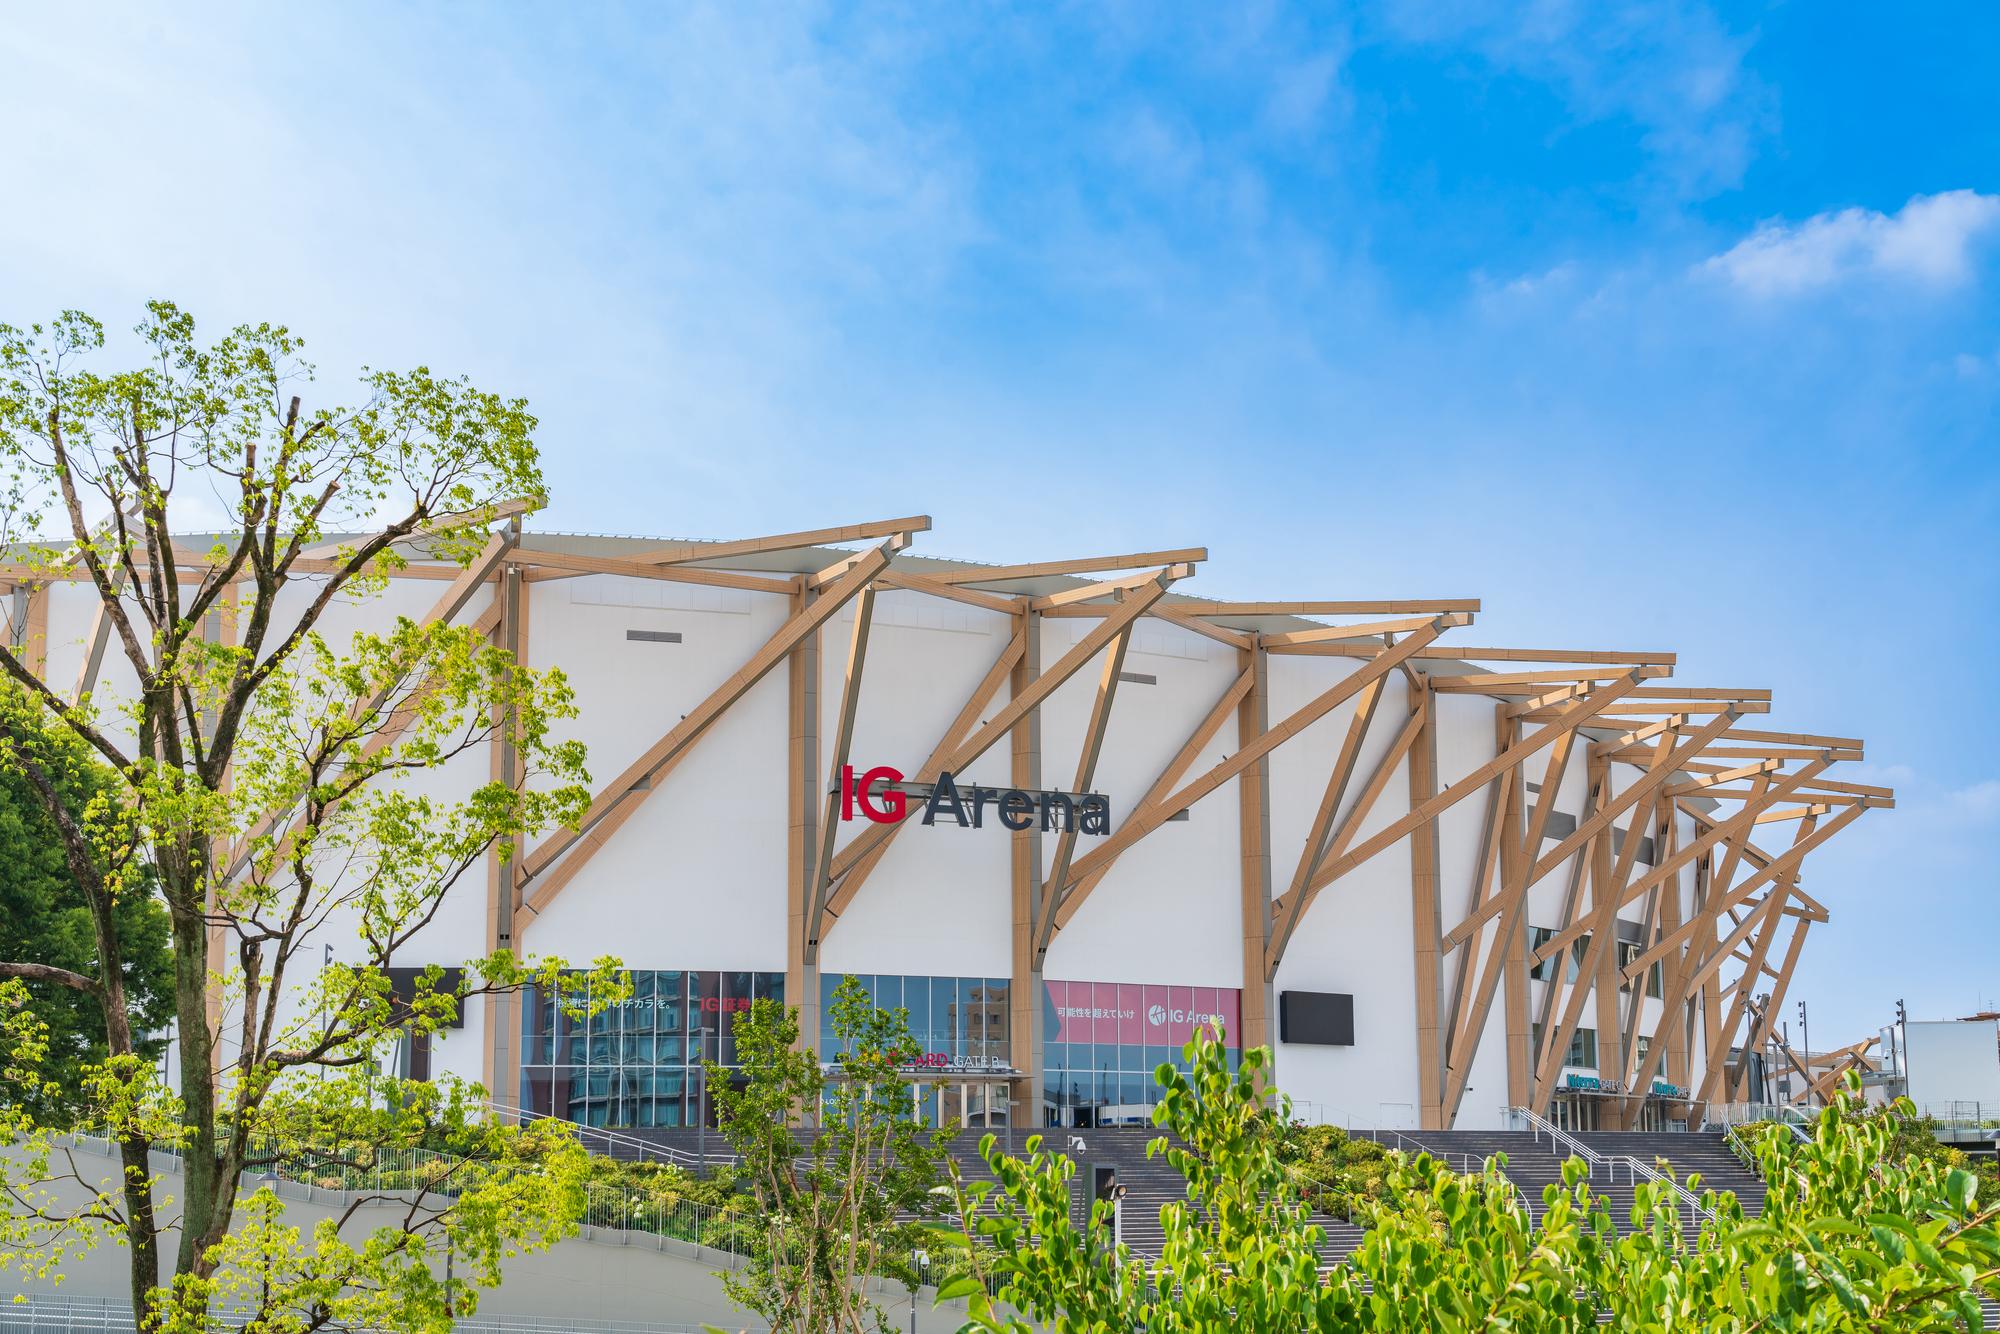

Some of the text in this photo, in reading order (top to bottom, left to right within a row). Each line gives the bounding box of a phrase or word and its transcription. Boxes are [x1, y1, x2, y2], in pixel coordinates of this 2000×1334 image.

[841, 765, 1110, 836] IG Arena
[1057, 1007, 1136, 1020] 可能性を超えていけ
[1169, 1009, 1184, 1023] IG
[954, 1055, 988, 1068] GATE
[990, 1056, 1000, 1068] B
